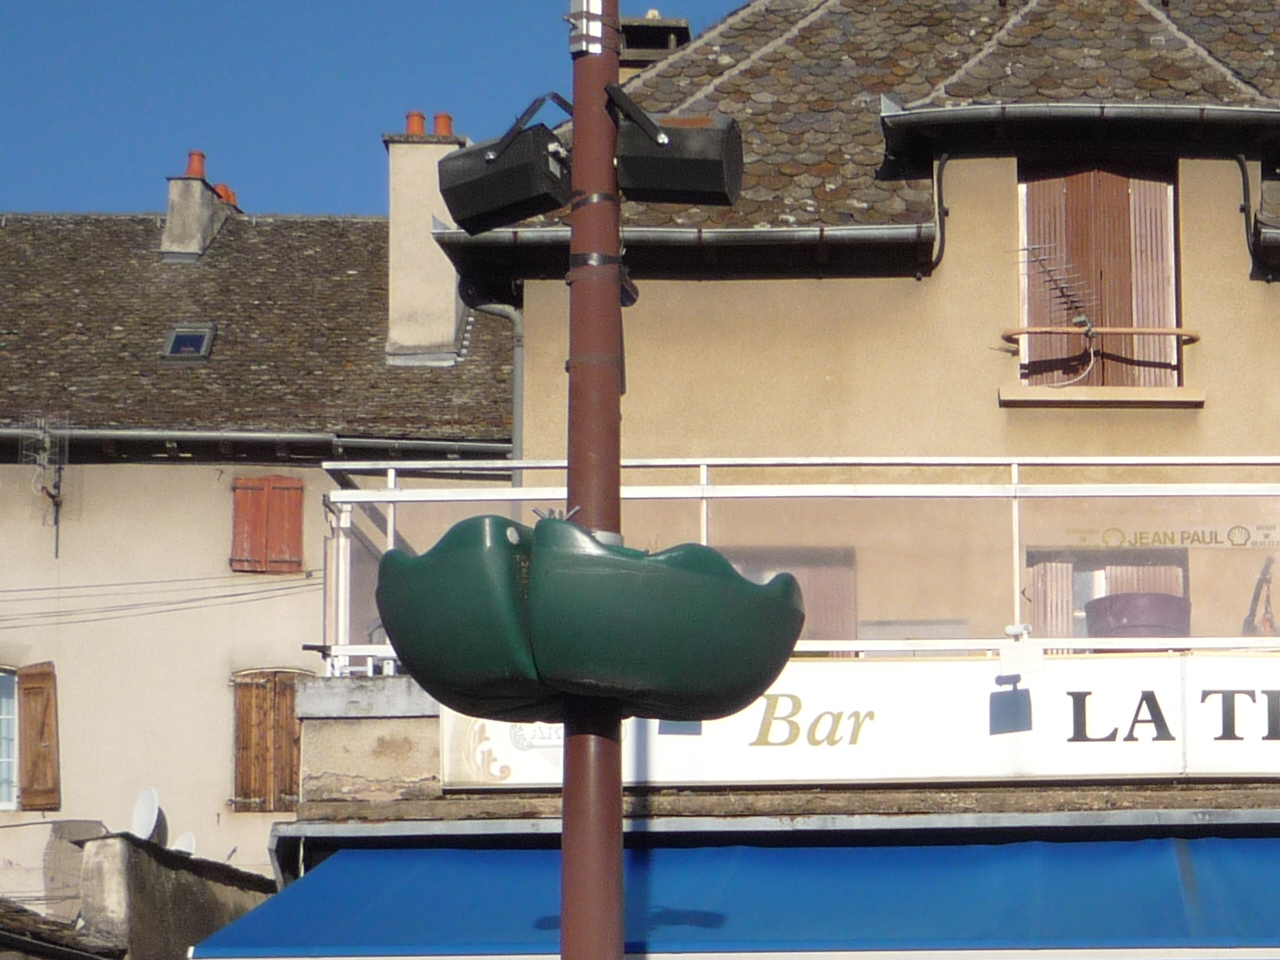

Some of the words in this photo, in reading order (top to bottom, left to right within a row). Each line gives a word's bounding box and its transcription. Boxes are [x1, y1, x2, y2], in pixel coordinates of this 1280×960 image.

[1128, 531, 1176, 547] JEAN
[1180, 530, 1224, 545] PAUL
[749, 693, 875, 747] Bar
[1066, 690, 1176, 743] LA
